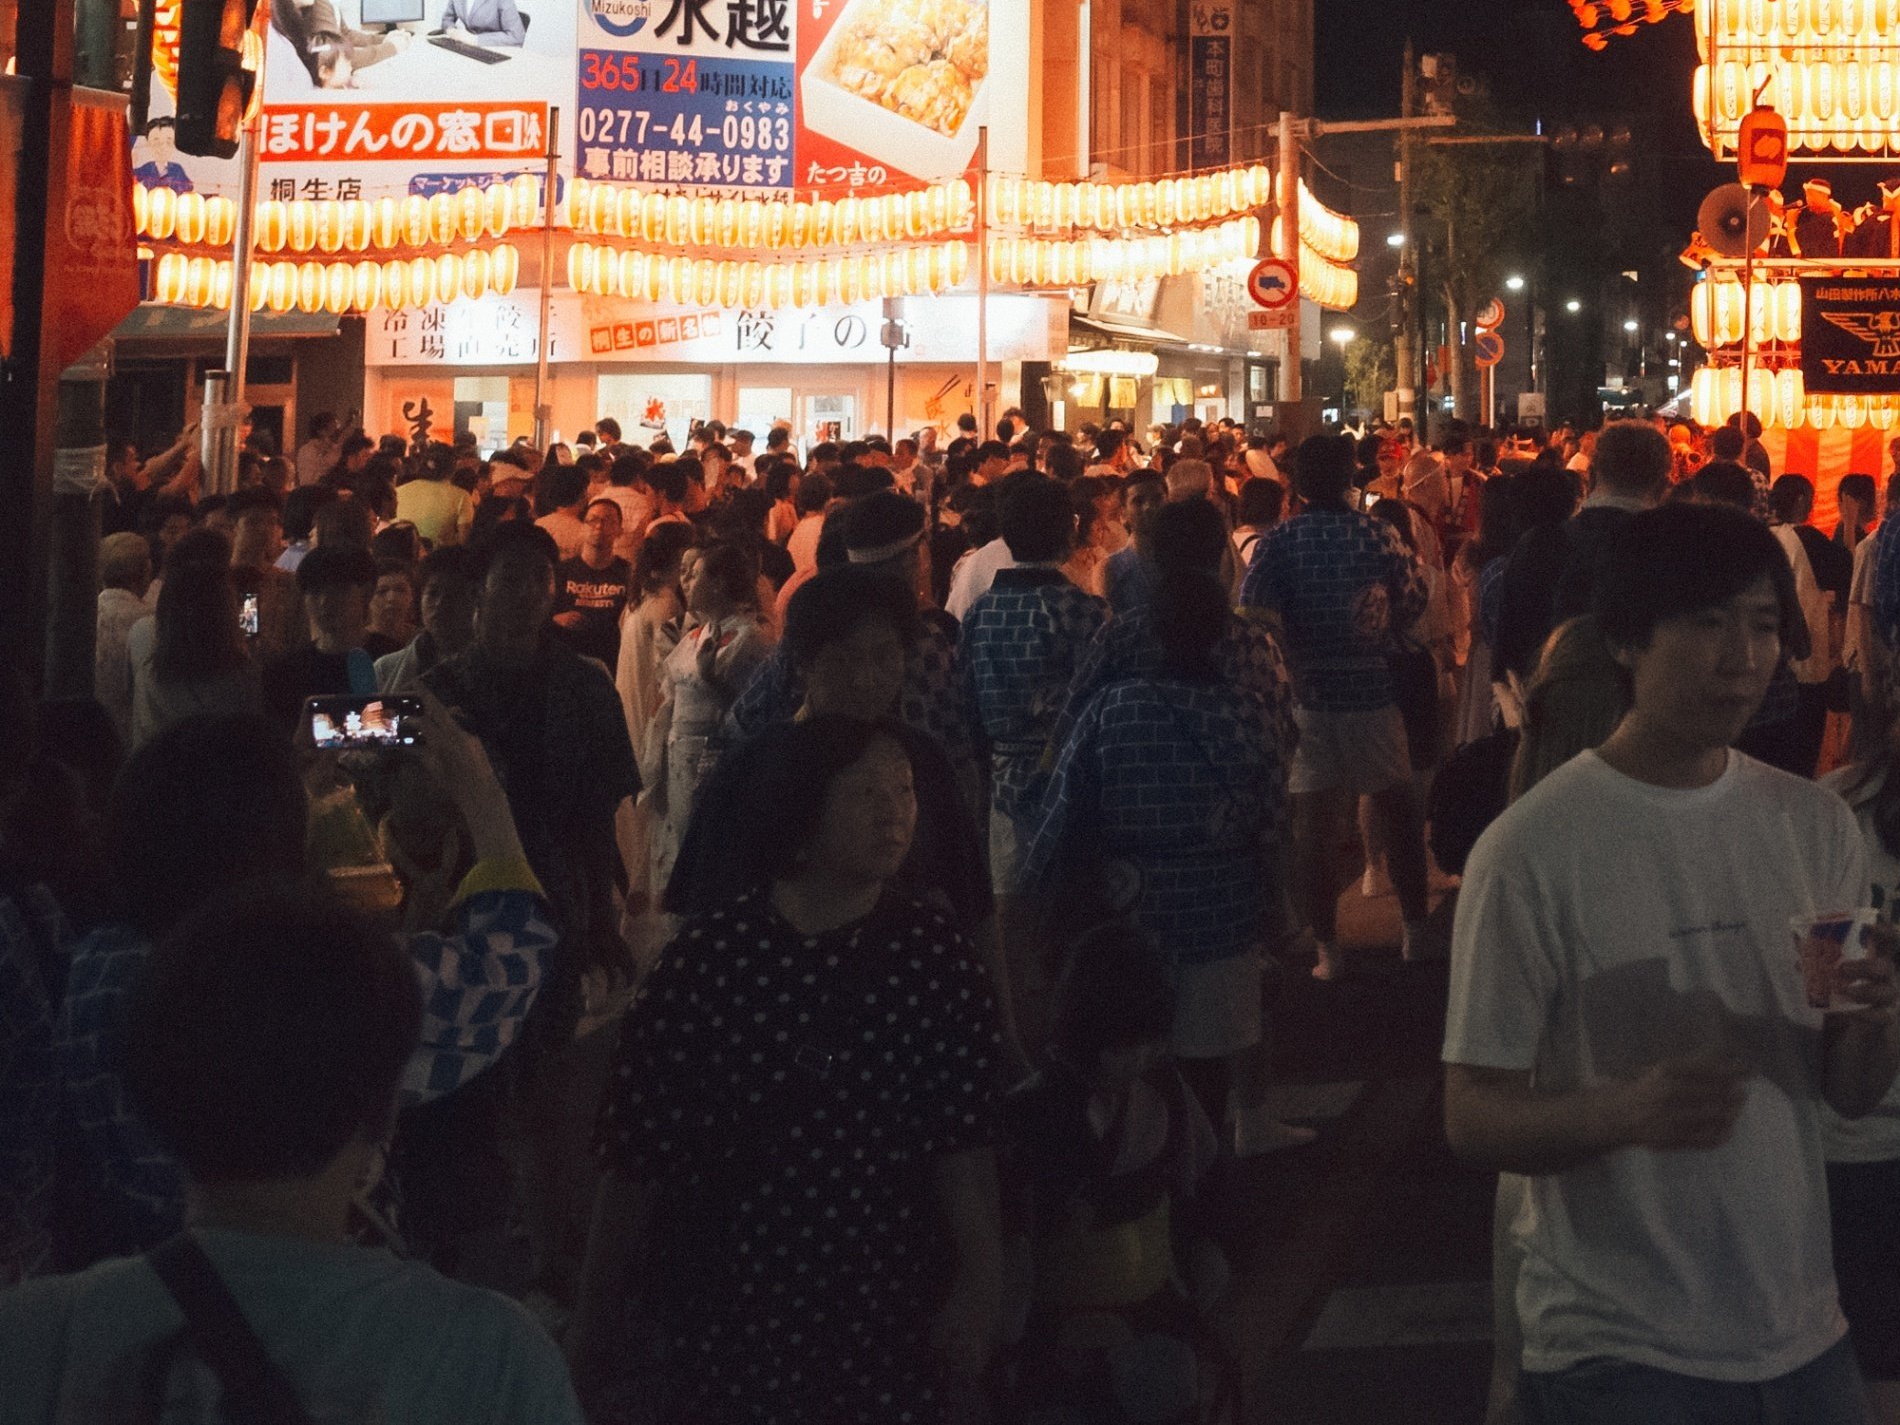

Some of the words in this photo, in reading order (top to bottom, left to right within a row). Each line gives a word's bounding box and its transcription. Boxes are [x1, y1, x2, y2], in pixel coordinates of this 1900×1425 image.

[725, 99, 791, 116] おくやみ
[259, 109, 542, 154] ほけんの窓口
[580, 106, 791, 153] 0277-44-0983
[584, 146, 790, 186] 事前相談承ります
[806, 160, 888, 185] たつ吉の
[565, 579, 627, 596] Rakuten
